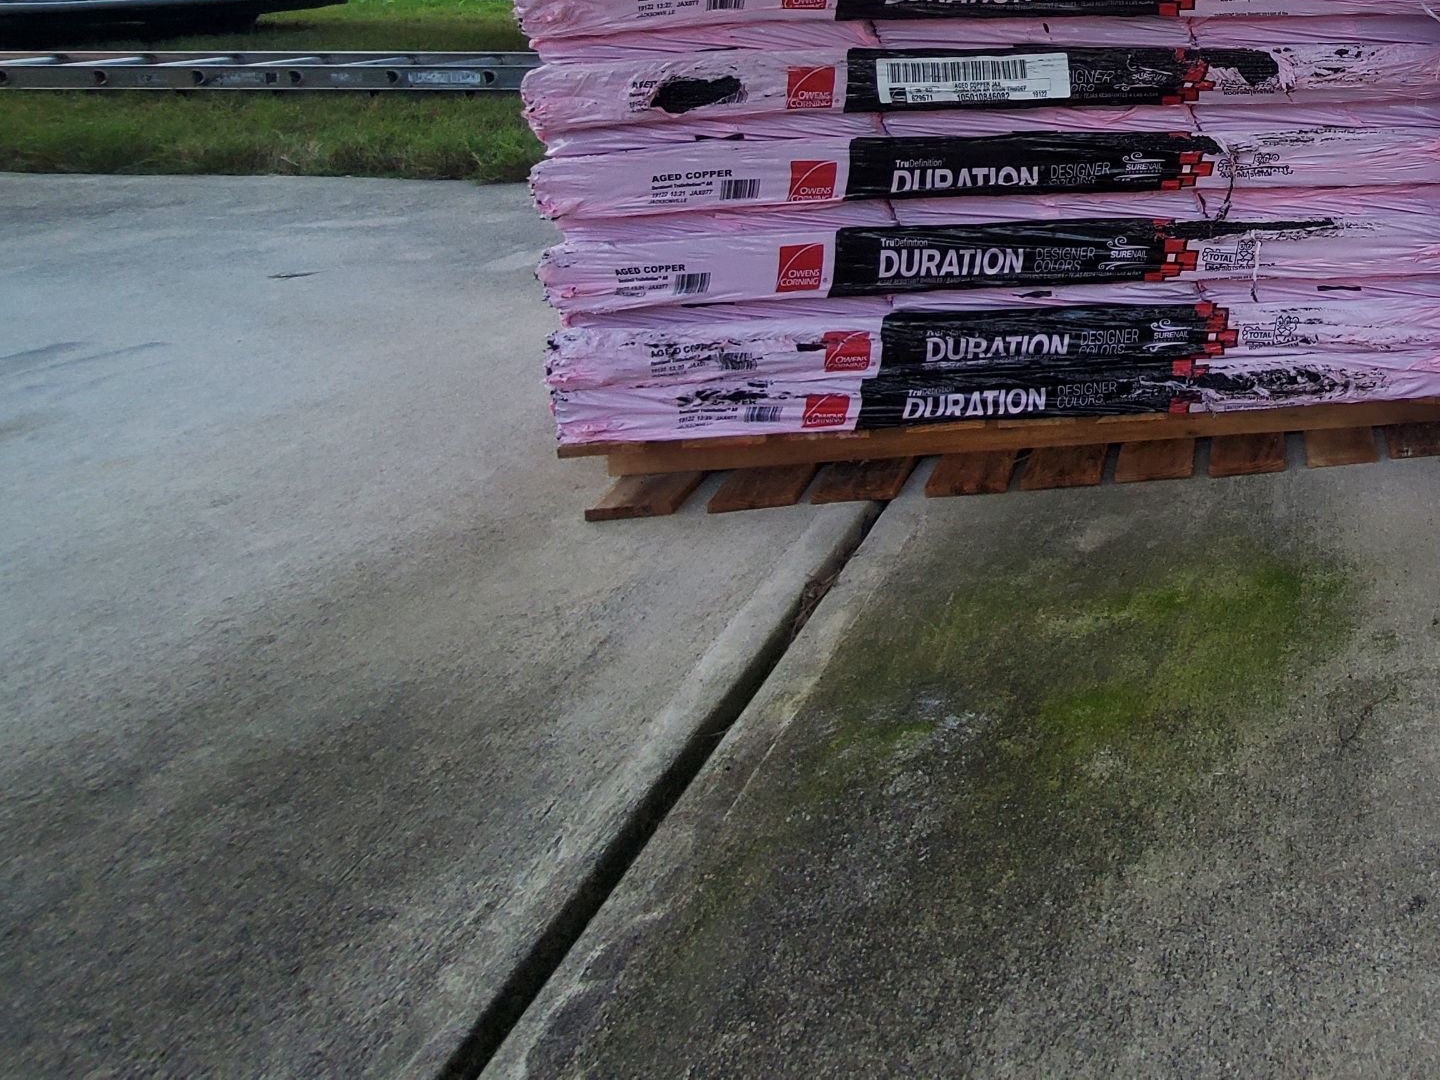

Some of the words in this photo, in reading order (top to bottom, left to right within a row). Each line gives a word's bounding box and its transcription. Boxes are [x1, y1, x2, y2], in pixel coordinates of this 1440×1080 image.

[799, 91, 830, 99] OWENS
[790, 99, 831, 108] CORNING
[1050, 162, 1111, 179] DESIGNER
[652, 173, 682, 183] AGED
[685, 169, 732, 180] COPPER
[800, 187, 831, 195] OWENS
[1035, 247, 1095, 260] DESIGNER
[1110, 250, 1148, 258] SURENAIL
[1209, 252, 1233, 262] TOTAL
[878, 248, 1024, 279] DURATION
[1034, 259, 1082, 272] COLORS
[615, 268, 641, 276] AGED
[643, 264, 685, 273] COPPER
[789, 269, 820, 278] OWENS
[780, 277, 819, 287] CORNING
[1081, 329, 1139, 345] DESIGNER
[1153, 331, 1189, 339] SURENAIL
[1249, 330, 1272, 339] TOTAL
[926, 332, 1069, 363] DURATION
[836, 356, 867, 364] OWENS
[902, 387, 1046, 420] DURATION
